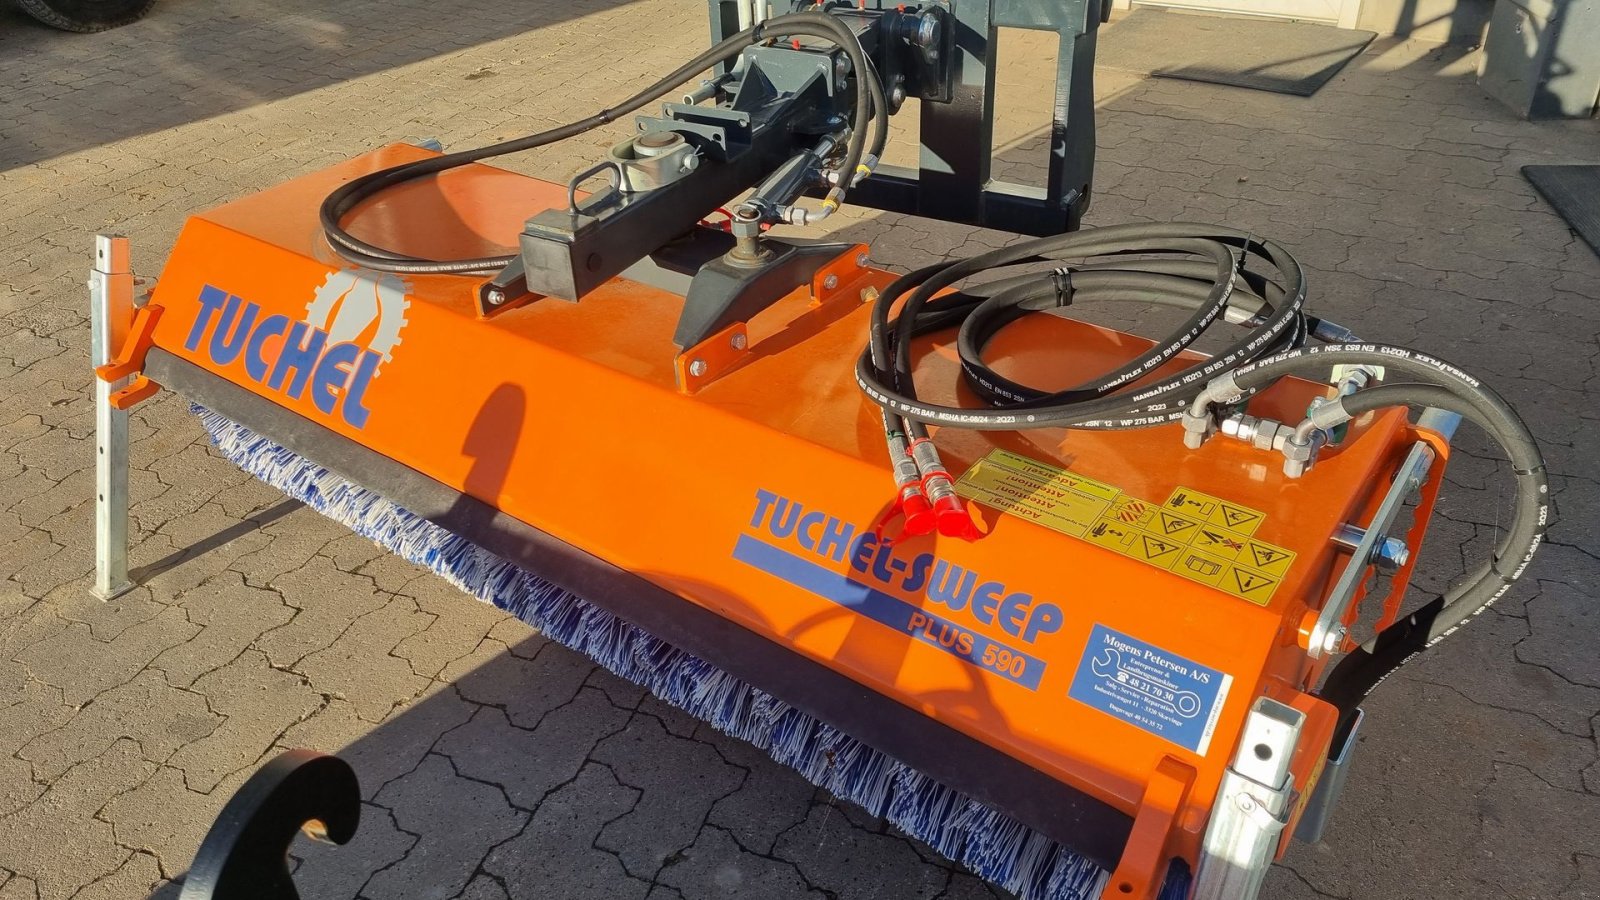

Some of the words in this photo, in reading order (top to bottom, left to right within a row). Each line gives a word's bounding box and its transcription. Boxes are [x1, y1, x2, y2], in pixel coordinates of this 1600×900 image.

[184, 283, 384, 430] TUCHEL
[1275, 353, 1288, 362] 275
[1288, 350, 1302, 359] WP
[1309, 346, 1319, 354] 12
[1324, 344, 1342, 352] 2SN
[1361, 344, 1375, 352] EN
[1380, 347, 1410, 358] HD213
[1143, 354, 1162, 369] HD213
[1182, 372, 1203, 384] HD213
[1204, 366, 1214, 374] EN
[1214, 361, 1224, 370] 853
[1224, 354, 1236, 364] 2SN
[1259, 355, 1275, 367] BAR
[900, 403, 911, 411] WP
[909, 406, 921, 415] 275
[921, 408, 936, 418] BAR
[938, 412, 960, 421] MSHA
[1147, 403, 1167, 412] 2Q23
[1120, 419, 1133, 427] WP
[1147, 416, 1165, 424] BAR
[1168, 412, 1184, 421] MSH
[1023, 465, 1079, 487] Advarsel!
[1006, 475, 1066, 498] Attention!
[995, 486, 1056, 508] Attention!
[988, 497, 1042, 519] Achtung!
[749, 487, 1064, 645] TUCHEL-SWEEP
[907, 611, 975, 656] PLUS
[981, 644, 1027, 679] 590
[1103, 634, 1142, 656] Mogens
[1144, 650, 1187, 675] Petersen
[1189, 670, 1210, 684] A/S
[1123, 663, 1179, 690] Landbrugsmaskiner
[1129, 678, 1140, 687] 48
[1140, 682, 1150, 691] 21
[1151, 687, 1163, 697] 70
[1163, 692, 1174, 701] 30
